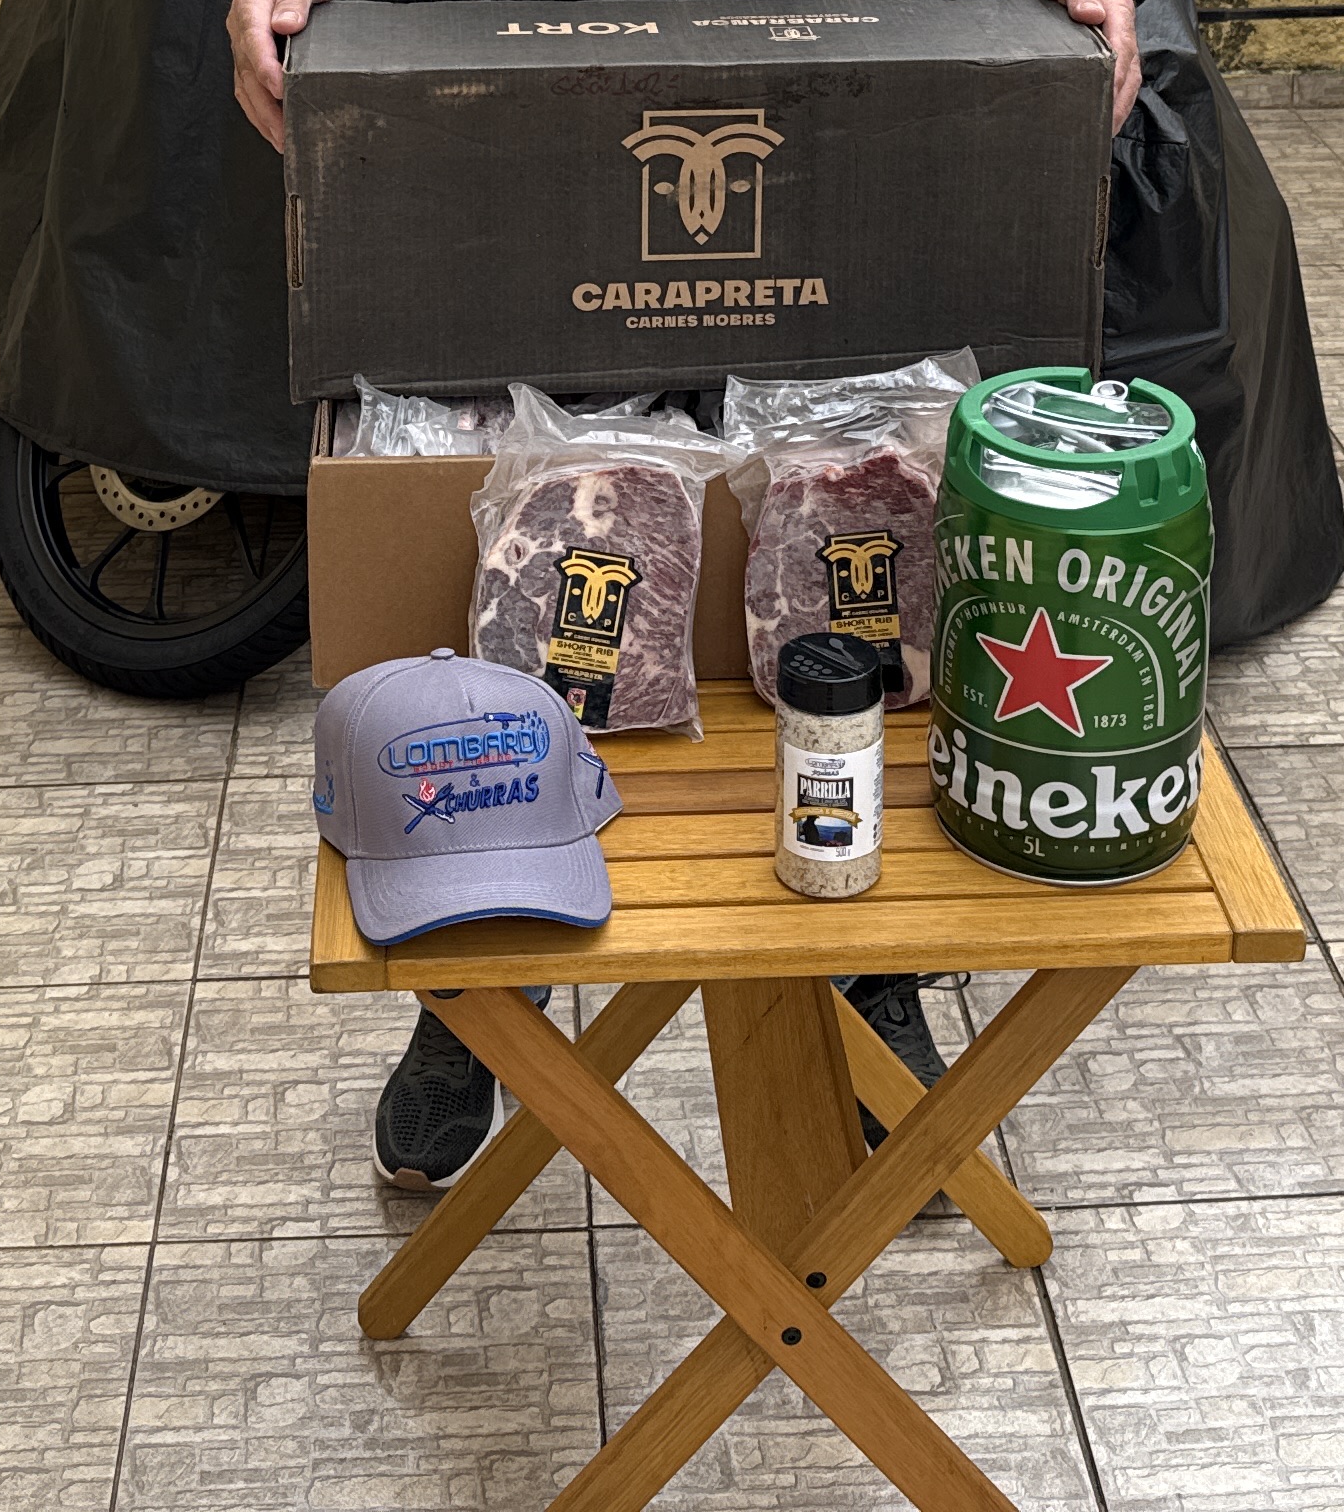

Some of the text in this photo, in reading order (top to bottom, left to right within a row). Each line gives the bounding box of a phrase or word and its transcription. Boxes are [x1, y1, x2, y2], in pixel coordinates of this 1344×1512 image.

[497, 21, 659, 36] KORT
[571, 278, 829, 311] CARAPRETA
[626, 313, 776, 329] CARNES NOBRES
[836, 618, 872, 629] SHORT
[955, 601, 1027, 629] D'HONNEUR
[1057, 548, 1202, 699] ORIGINAL
[556, 640, 593, 653] SHORT
[595, 647, 614, 657] RIB
[1057, 611, 1144, 663] AMSTERDAM
[1138, 666, 1153, 686] EN
[963, 684, 1127, 728] EST. 1873
[1143, 693, 1154, 731] 1883
[446, 773, 539, 813] CHURRAS
[469, 773, 481, 787] &
[800, 777, 851, 799] PARRILLA
[1022, 836, 1045, 857] 5L
[1073, 830, 1167, 853] PREMIUM
